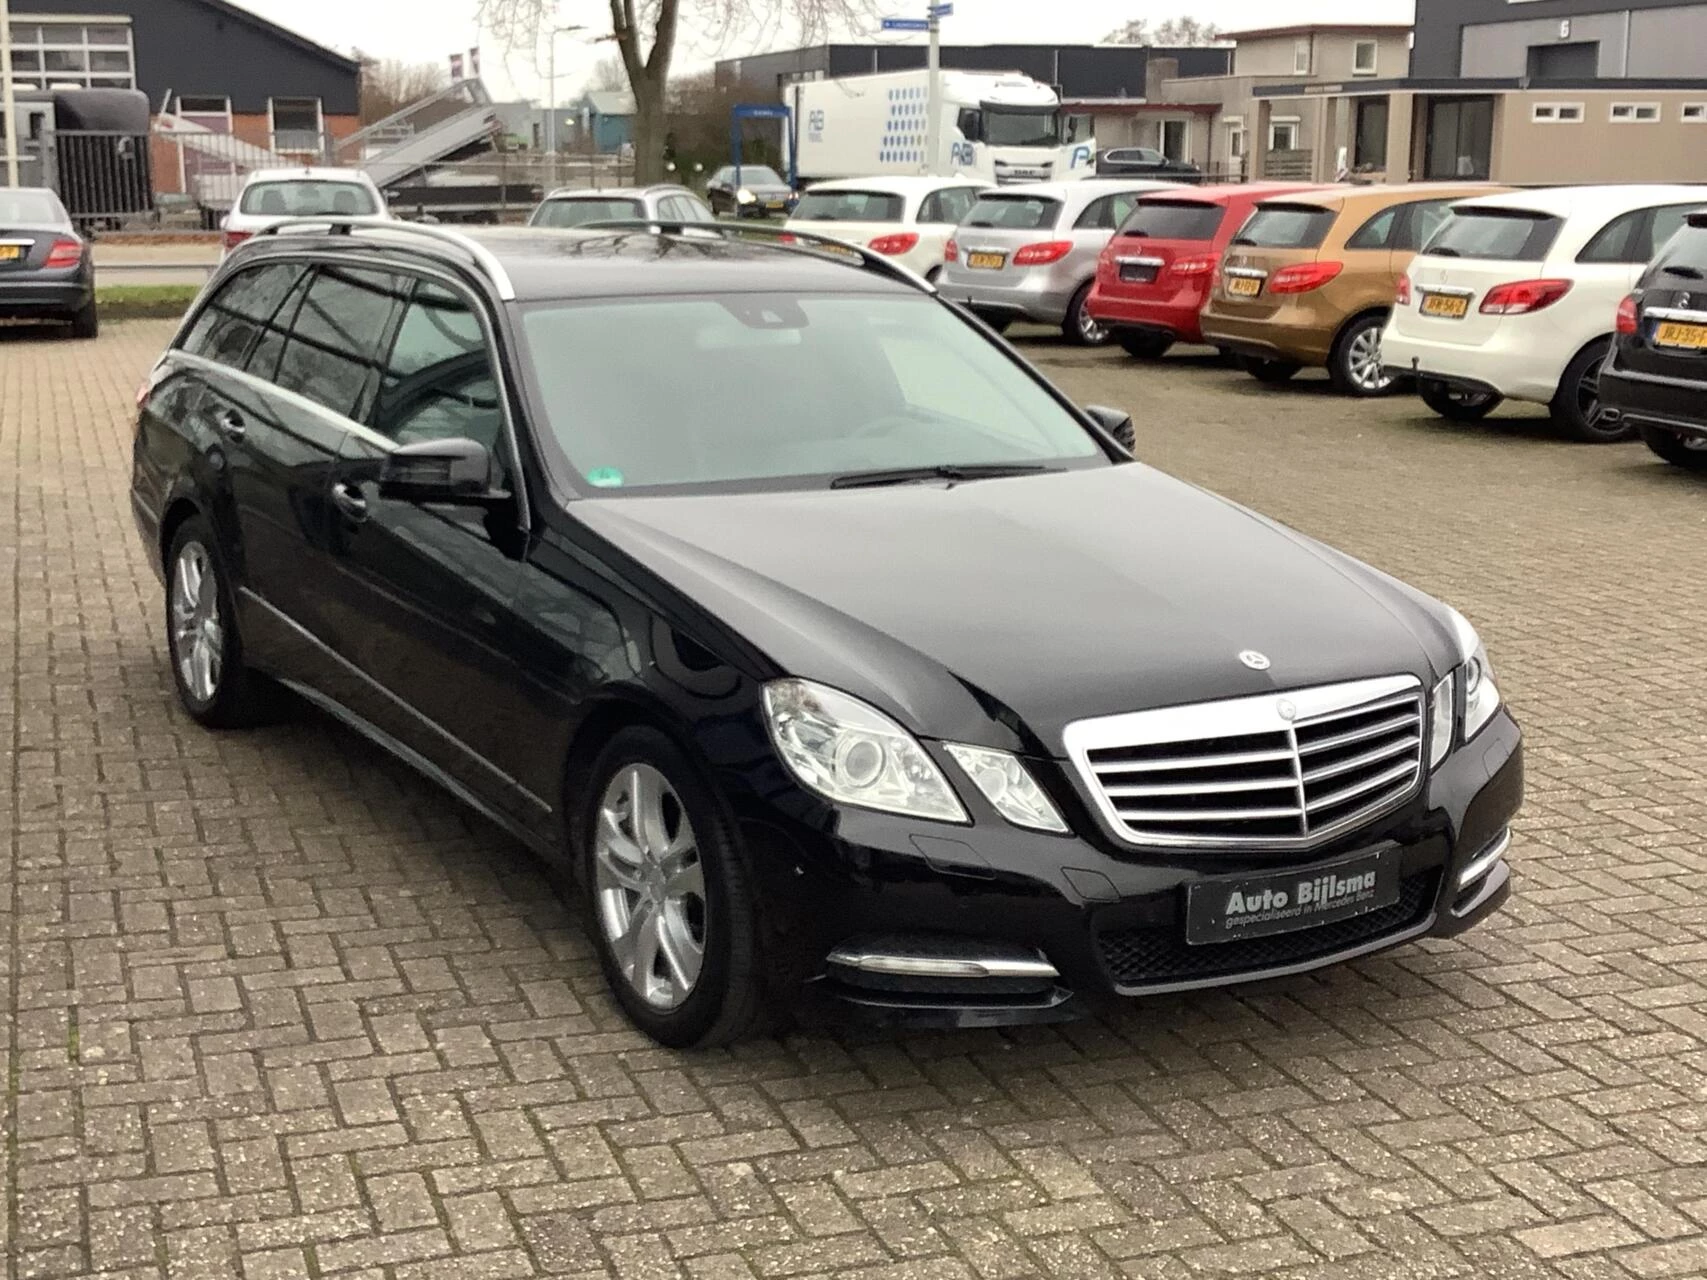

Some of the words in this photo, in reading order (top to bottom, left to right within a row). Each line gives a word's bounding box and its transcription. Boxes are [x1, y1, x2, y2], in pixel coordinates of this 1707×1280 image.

[1560, 19, 1570, 38] 6
[1225, 889, 1289, 915] Auto
[1297, 871, 1376, 907] Bijlsma
